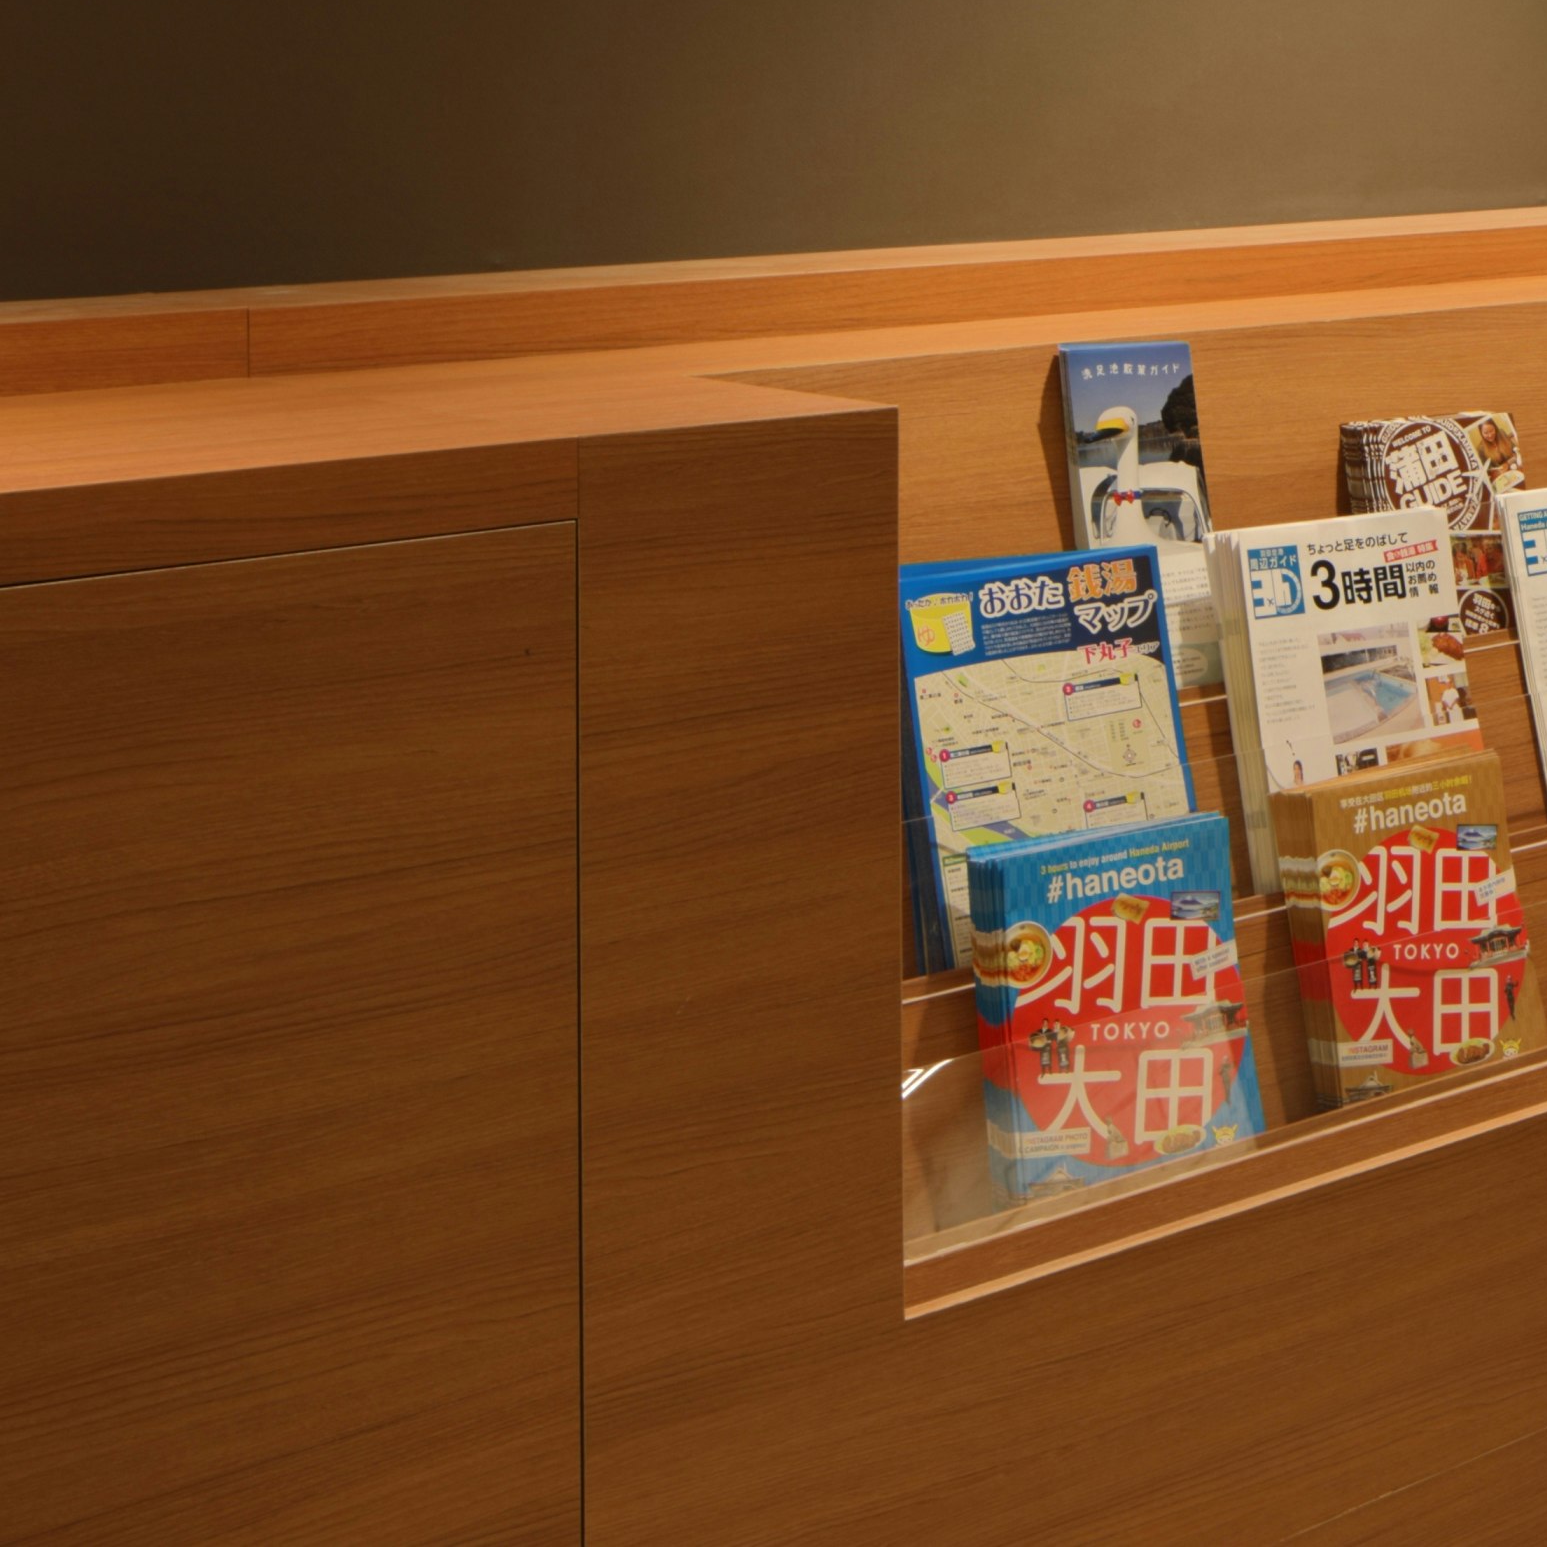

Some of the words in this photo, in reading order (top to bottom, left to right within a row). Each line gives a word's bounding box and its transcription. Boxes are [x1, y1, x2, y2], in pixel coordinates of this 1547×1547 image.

[1400, 469, 1468, 510] GUIDE
[1307, 532, 1408, 556] ちょっと足をのばして
[1406, 559, 1436, 573] 以内の
[979, 576, 1065, 618] おおた
[1067, 559, 1138, 602] 銭湯
[1310, 559, 1407, 610] 3時間
[1073, 589, 1159, 635] マップ
[1353, 792, 1467, 834] #haneota
[1079, 856, 1100, 868] enjoy
[1101, 850, 1128, 864] around
[1161, 838, 1189, 854] Airport
[1046, 856, 1185, 903] #haneota
[1327, 845, 1498, 936] 羽田
[1014, 916, 1218, 1013] 羽田
[1393, 942, 1460, 960] TOKYO
[1090, 1021, 1170, 1041] TOKYO
[1350, 963, 1499, 1056] 大田
[1037, 1045, 1214, 1146] 大田
